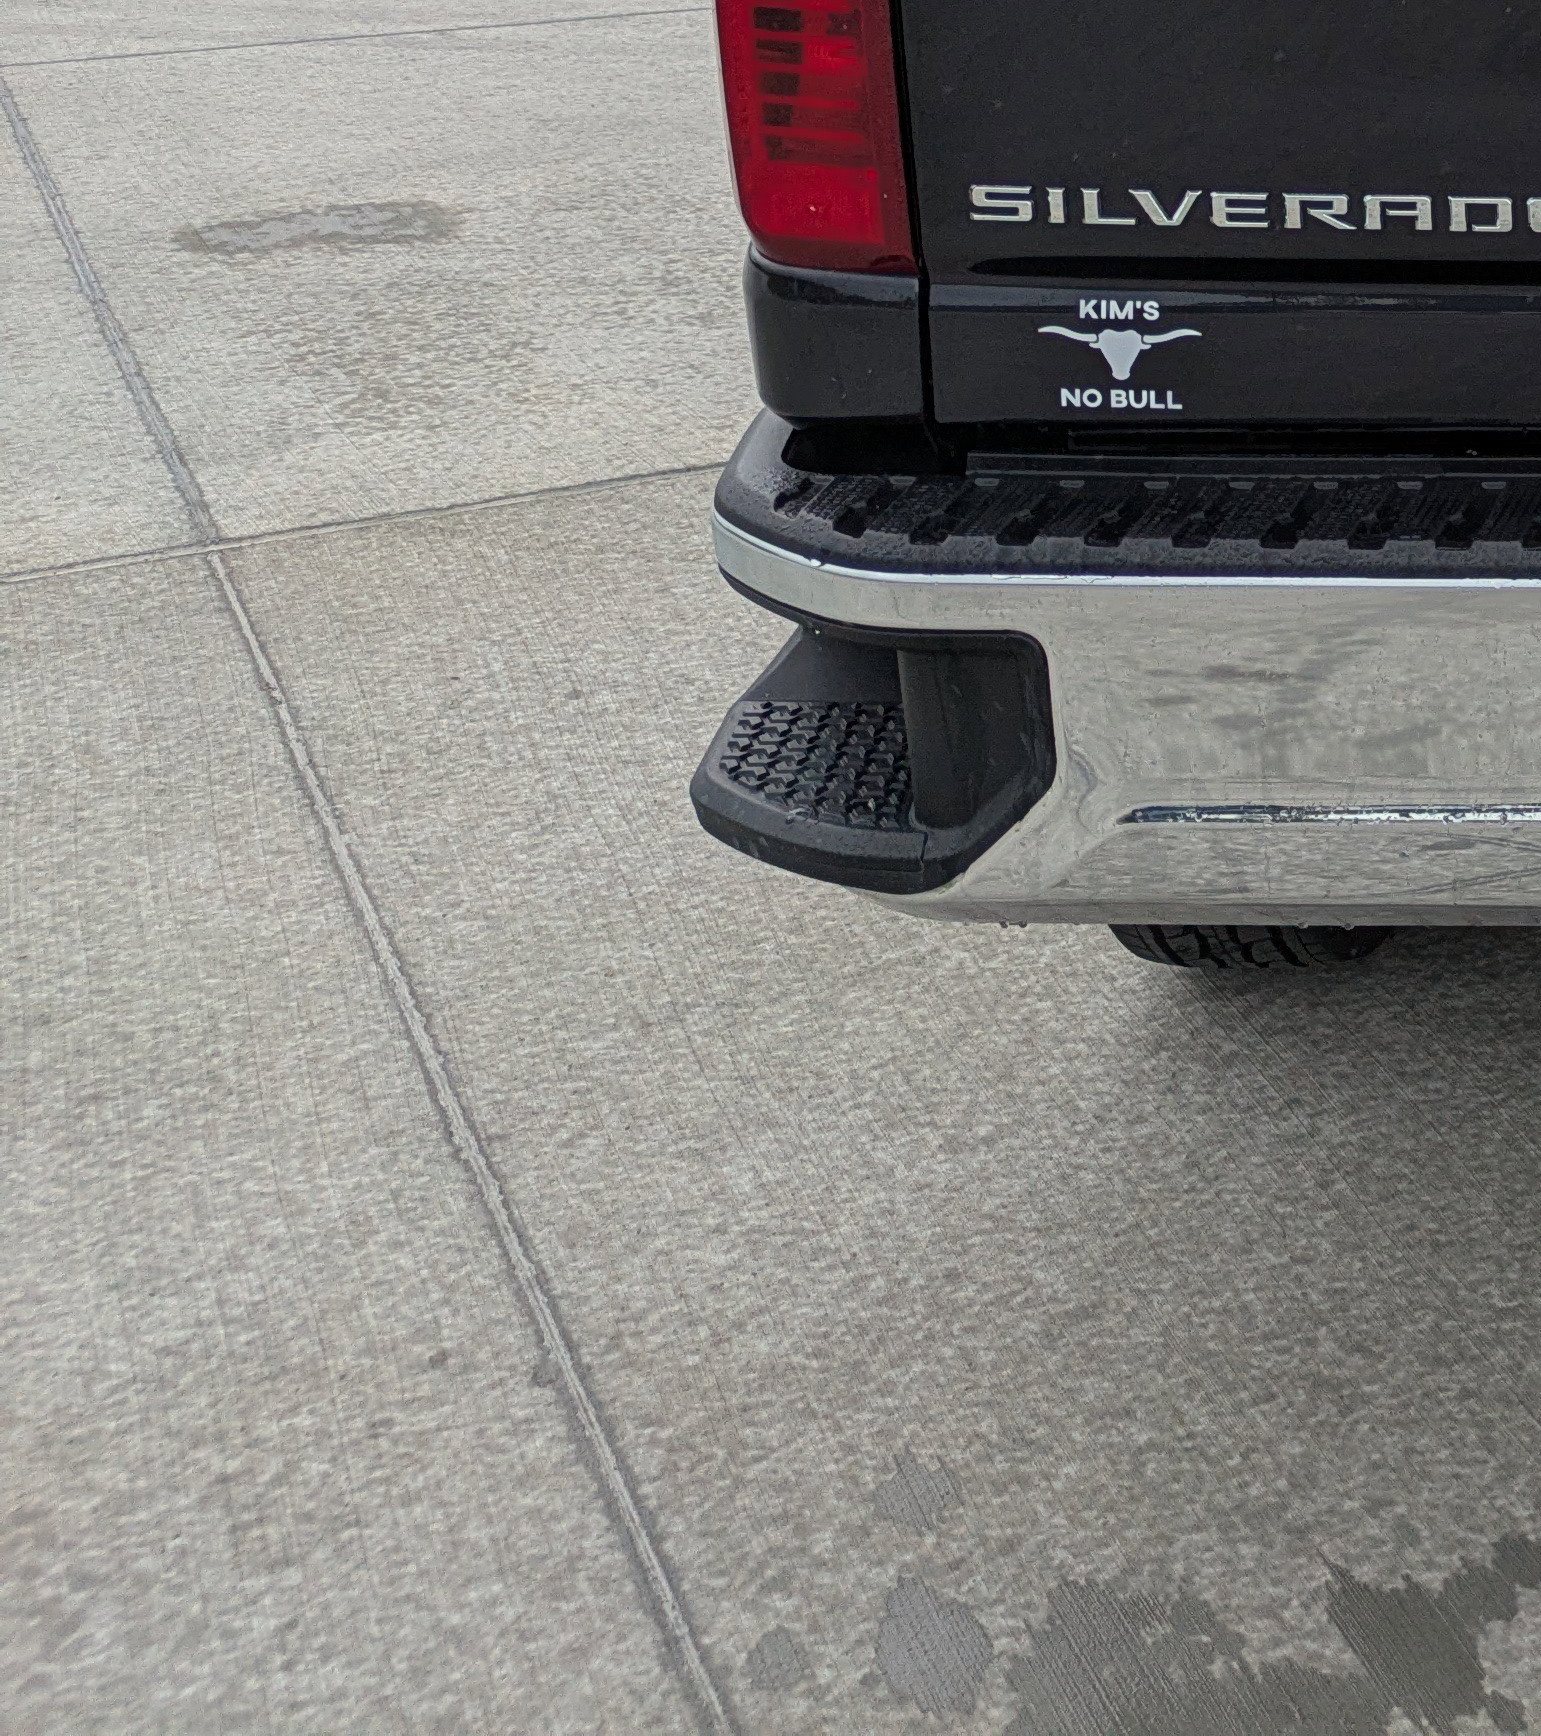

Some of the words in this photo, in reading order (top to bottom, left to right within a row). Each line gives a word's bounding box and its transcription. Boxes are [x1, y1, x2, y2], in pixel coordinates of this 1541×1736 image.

[1079, 299, 1160, 321] KIM'S
[1060, 387, 1103, 409] NO
[1110, 389, 1183, 410] BULL
